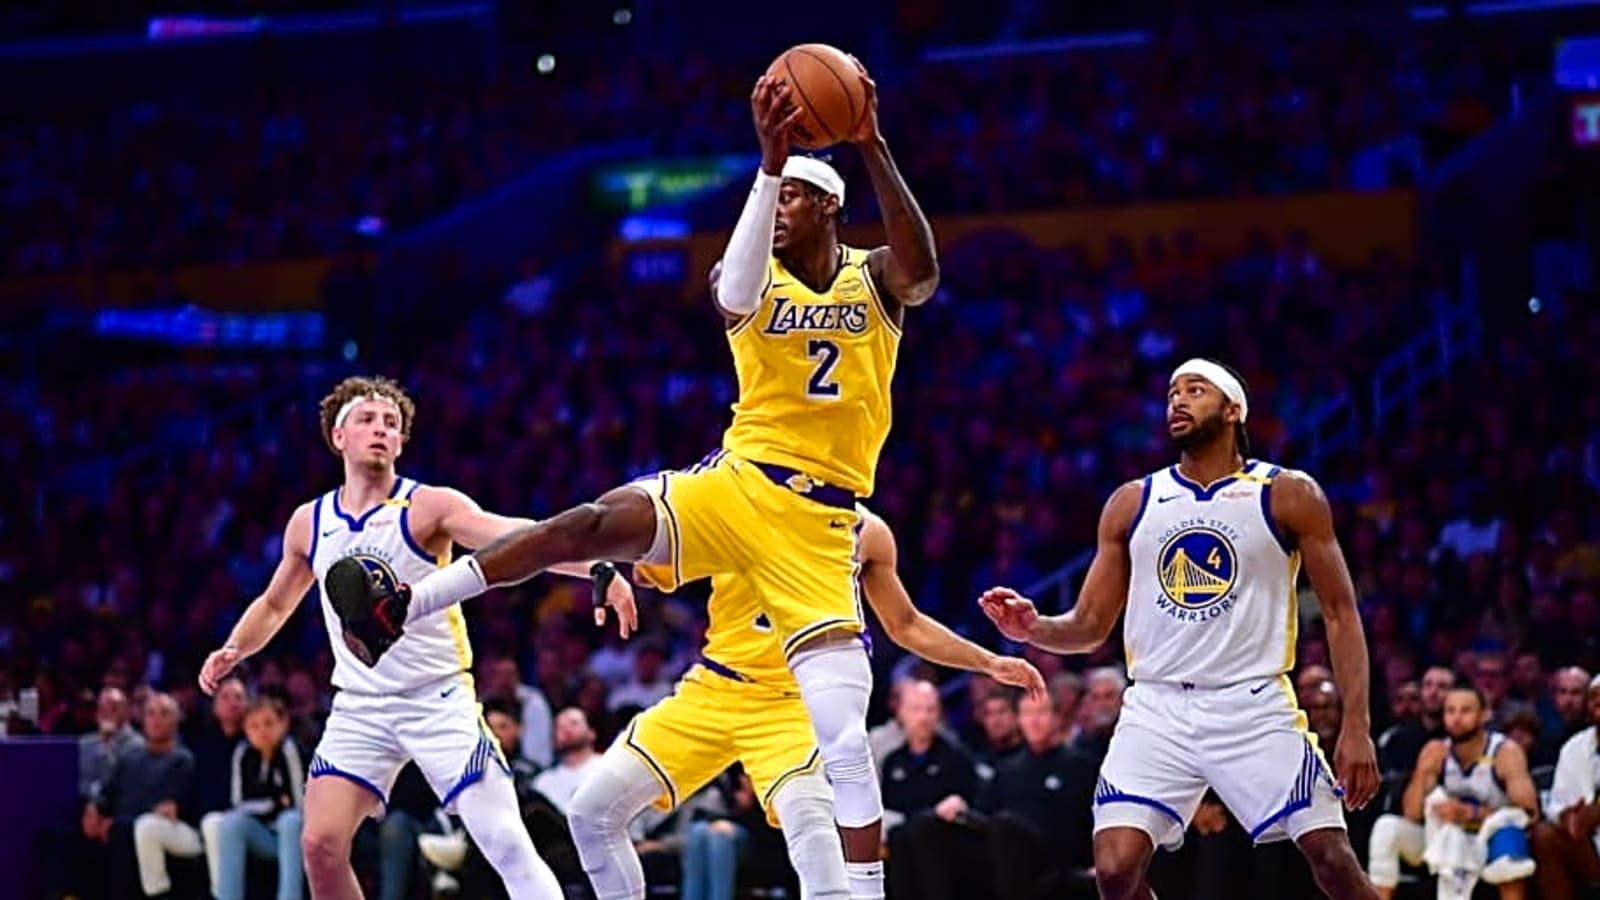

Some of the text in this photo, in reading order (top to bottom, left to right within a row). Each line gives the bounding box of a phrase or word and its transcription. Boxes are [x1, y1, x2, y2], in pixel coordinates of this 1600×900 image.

[763, 297, 868, 335] LAKERS
[806, 339, 841, 399] 2
[1158, 519, 1239, 543] GOLDEN STATE
[1207, 547, 1221, 570] 4
[1156, 592, 1238, 622] WARRIORS
